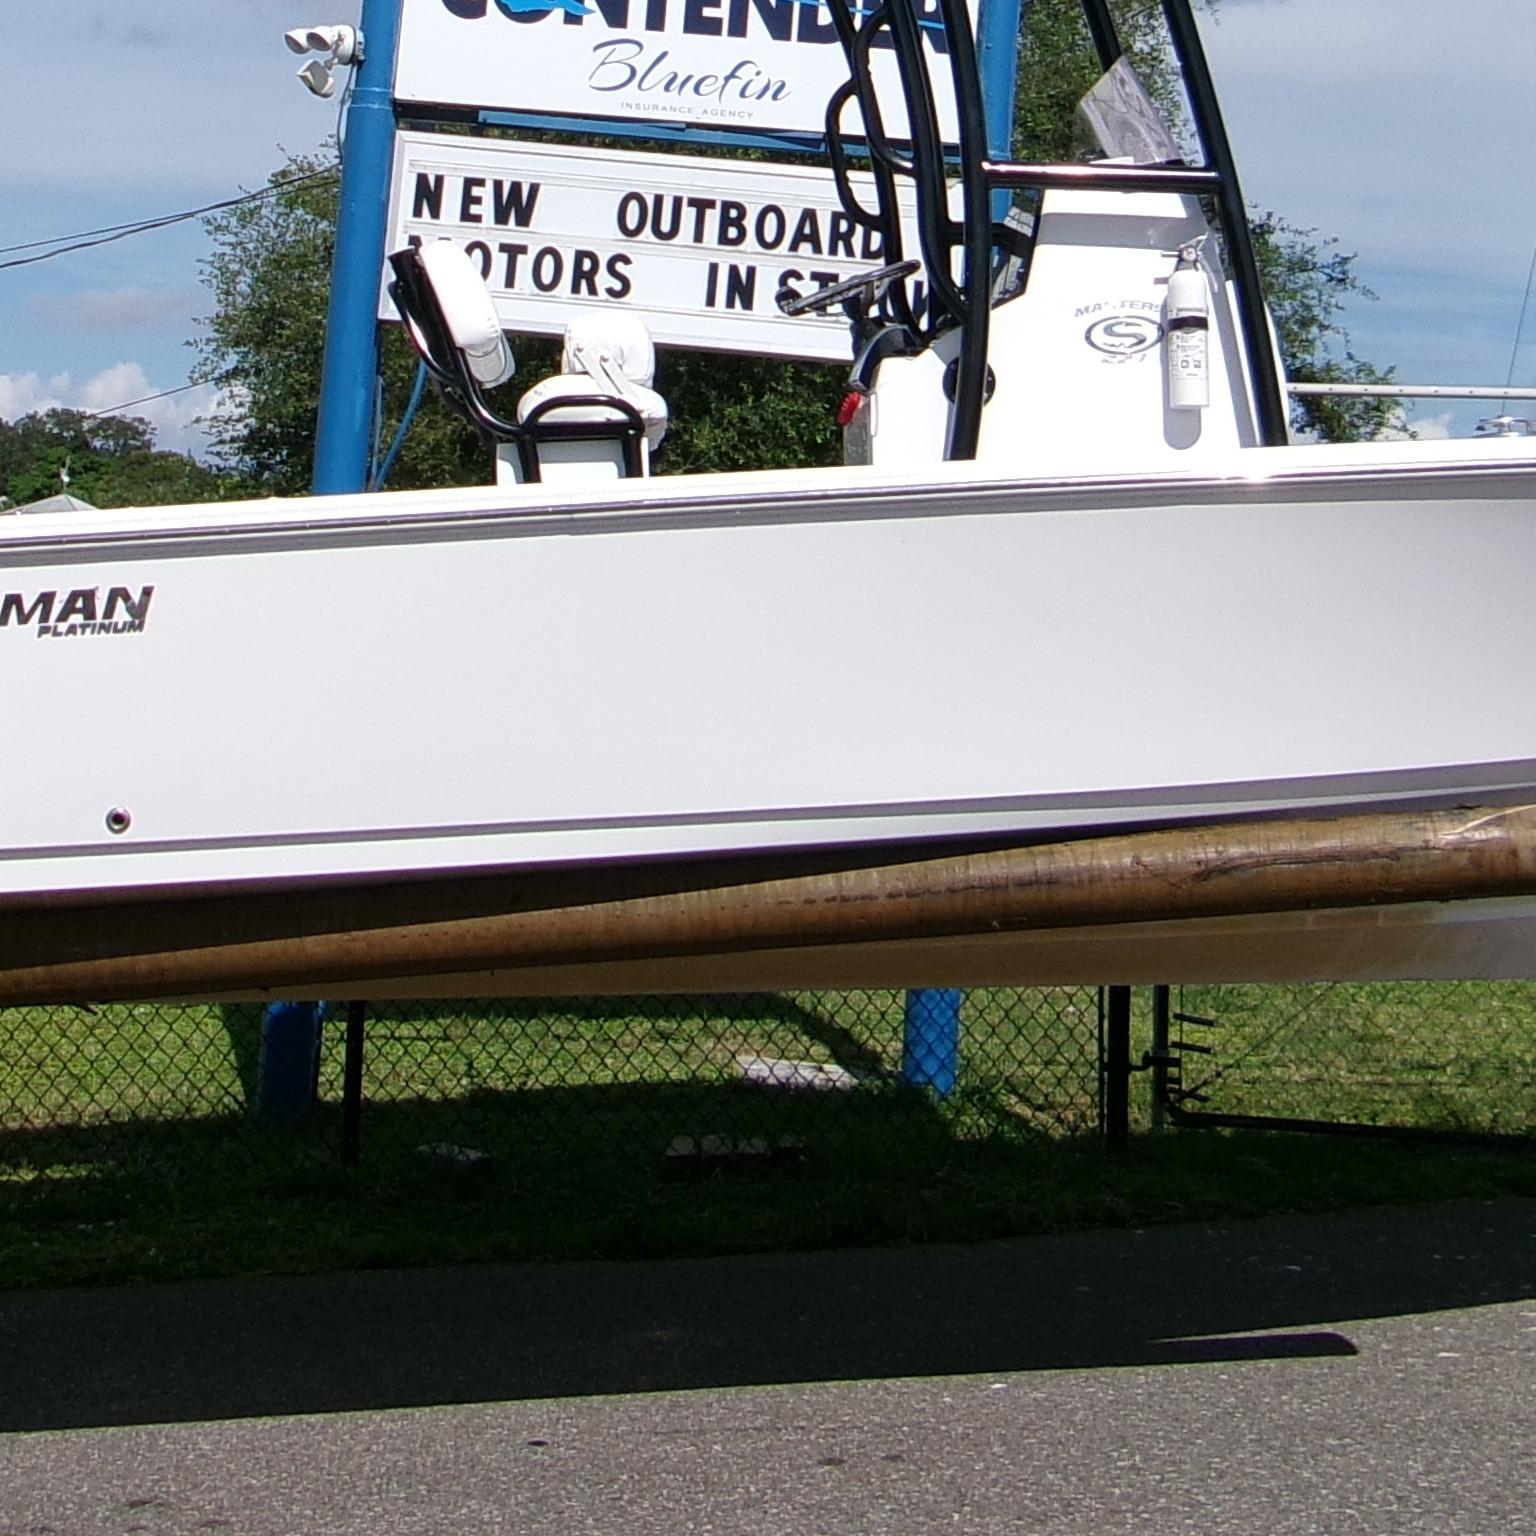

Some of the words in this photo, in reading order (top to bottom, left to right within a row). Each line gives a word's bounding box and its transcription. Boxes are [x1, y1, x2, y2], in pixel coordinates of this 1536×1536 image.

[588, 38, 792, 104] Bluefin
[620, 102, 694, 116] INSURANCE
[702, 107, 754, 120] AGENCY
[411, 173, 540, 228] NEW
[408, 235, 632, 299] OTORS
[704, 261, 757, 311] IN
[36, 619, 145, 639] PLATINUM
